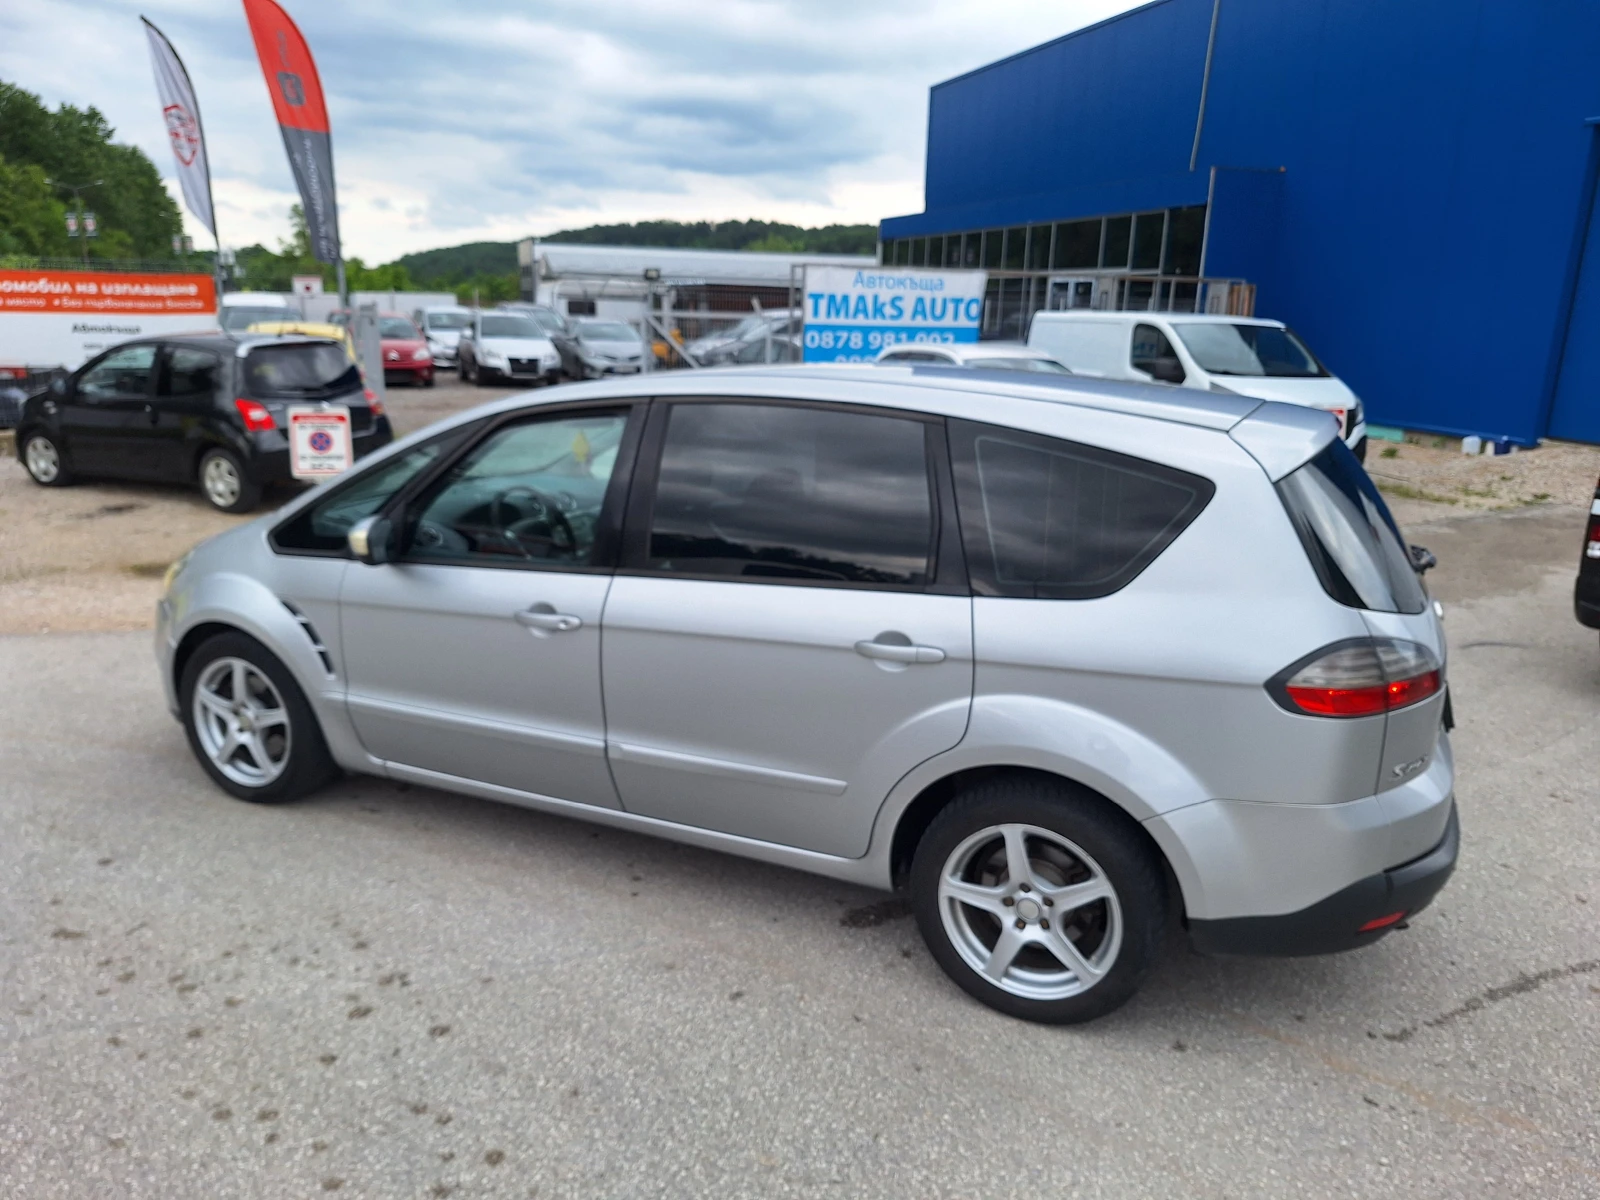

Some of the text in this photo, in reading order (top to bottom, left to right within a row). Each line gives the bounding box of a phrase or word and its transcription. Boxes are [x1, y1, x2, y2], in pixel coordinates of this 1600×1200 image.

[0, 277, 198, 297] омобил на изплащане
[852, 271, 945, 291] Автокъща
[808, 293, 981, 322] TMAkS AUTO
[804, 330, 863, 349] 0878
[867, 331, 909, 350] 981
